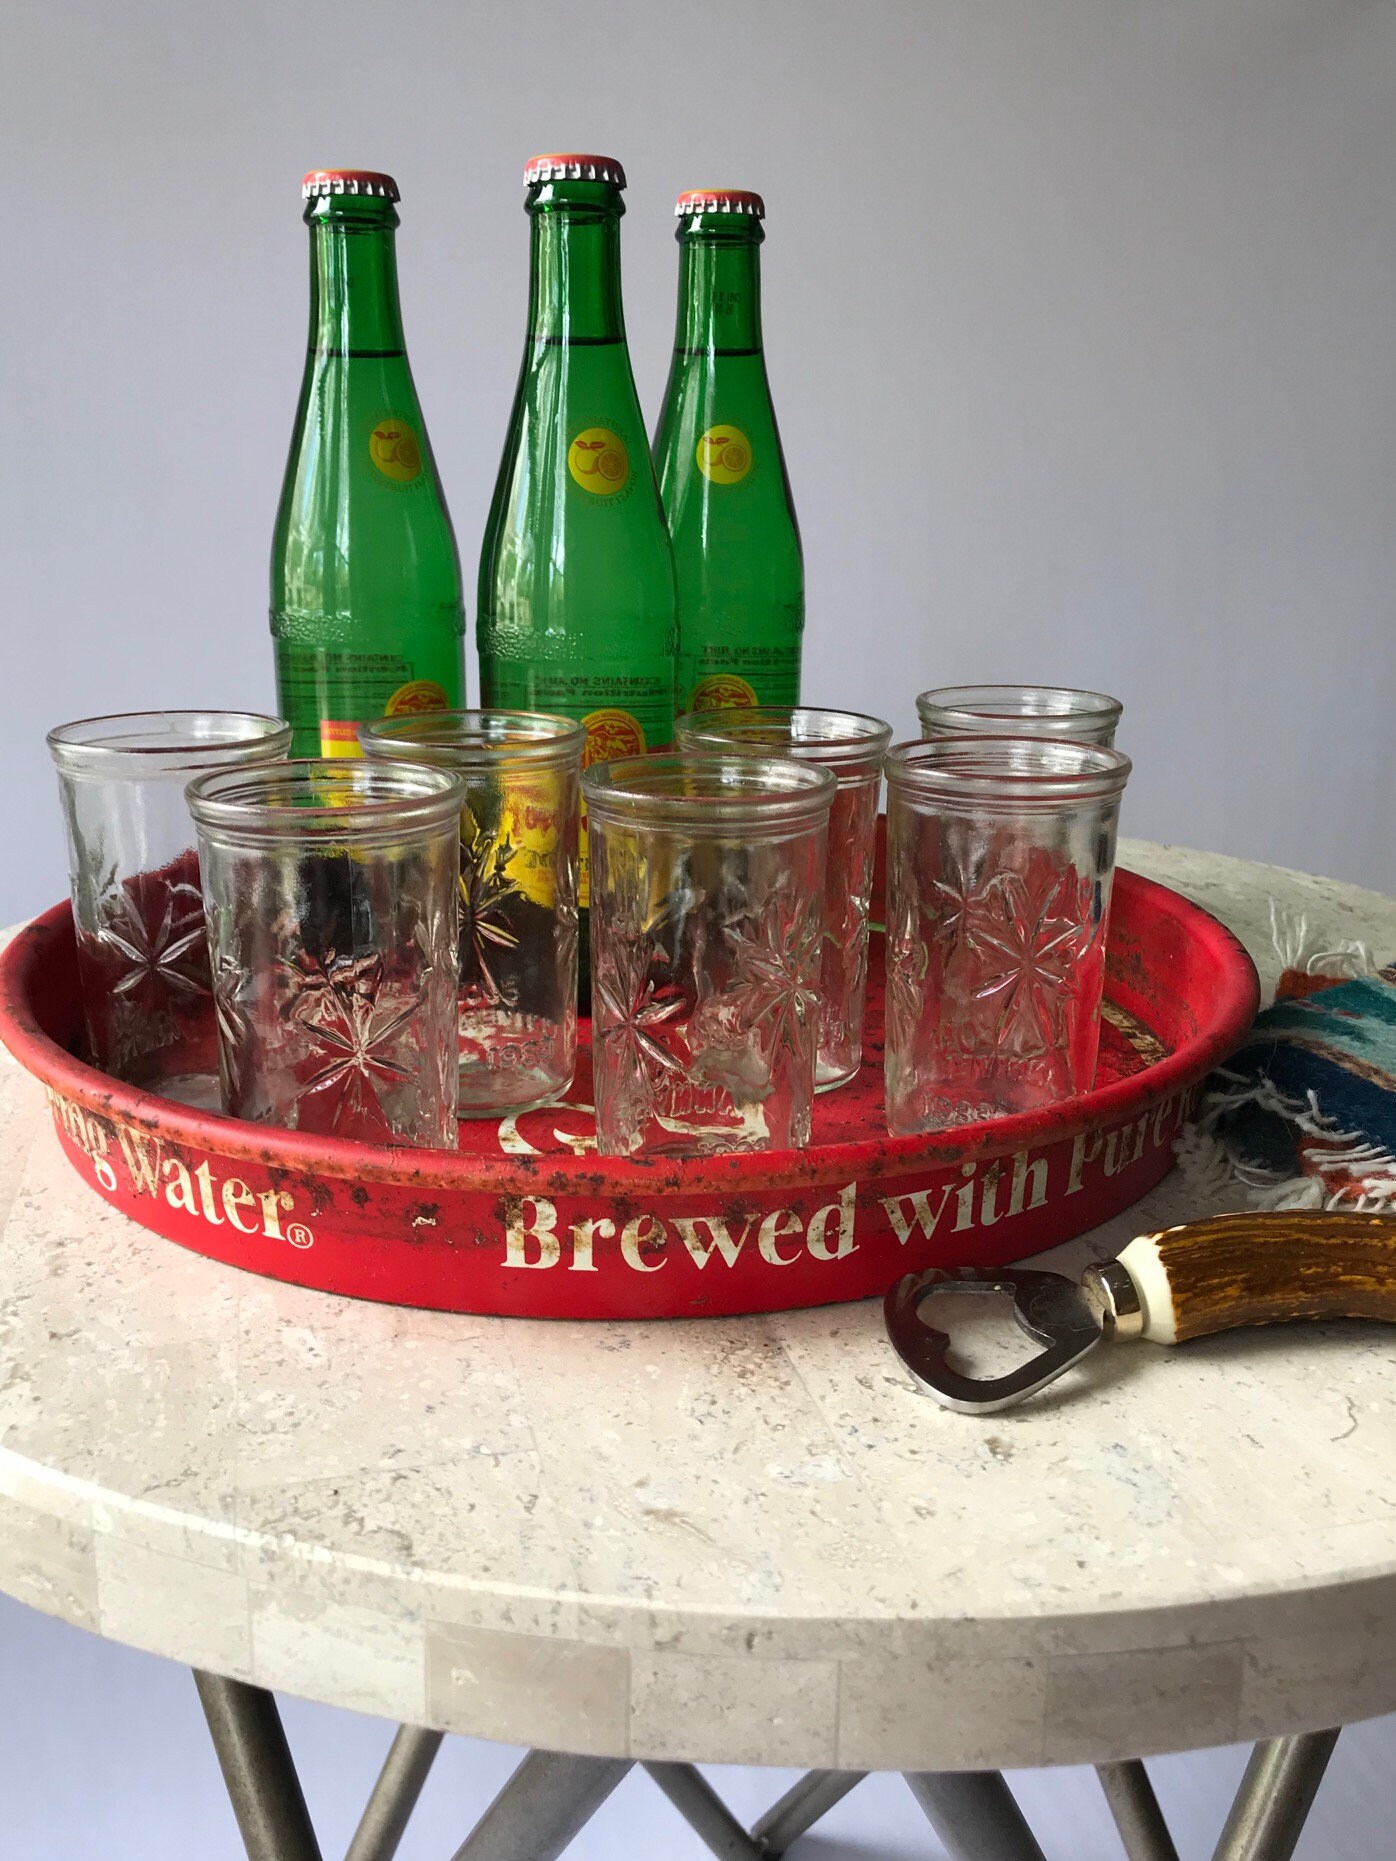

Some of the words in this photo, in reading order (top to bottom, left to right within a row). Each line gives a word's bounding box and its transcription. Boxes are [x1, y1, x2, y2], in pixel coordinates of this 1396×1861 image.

[500, 1181, 859, 1273] Brewed
[879, 1150, 1049, 1246] with
[1063, 1099, 1173, 1196] Pure
